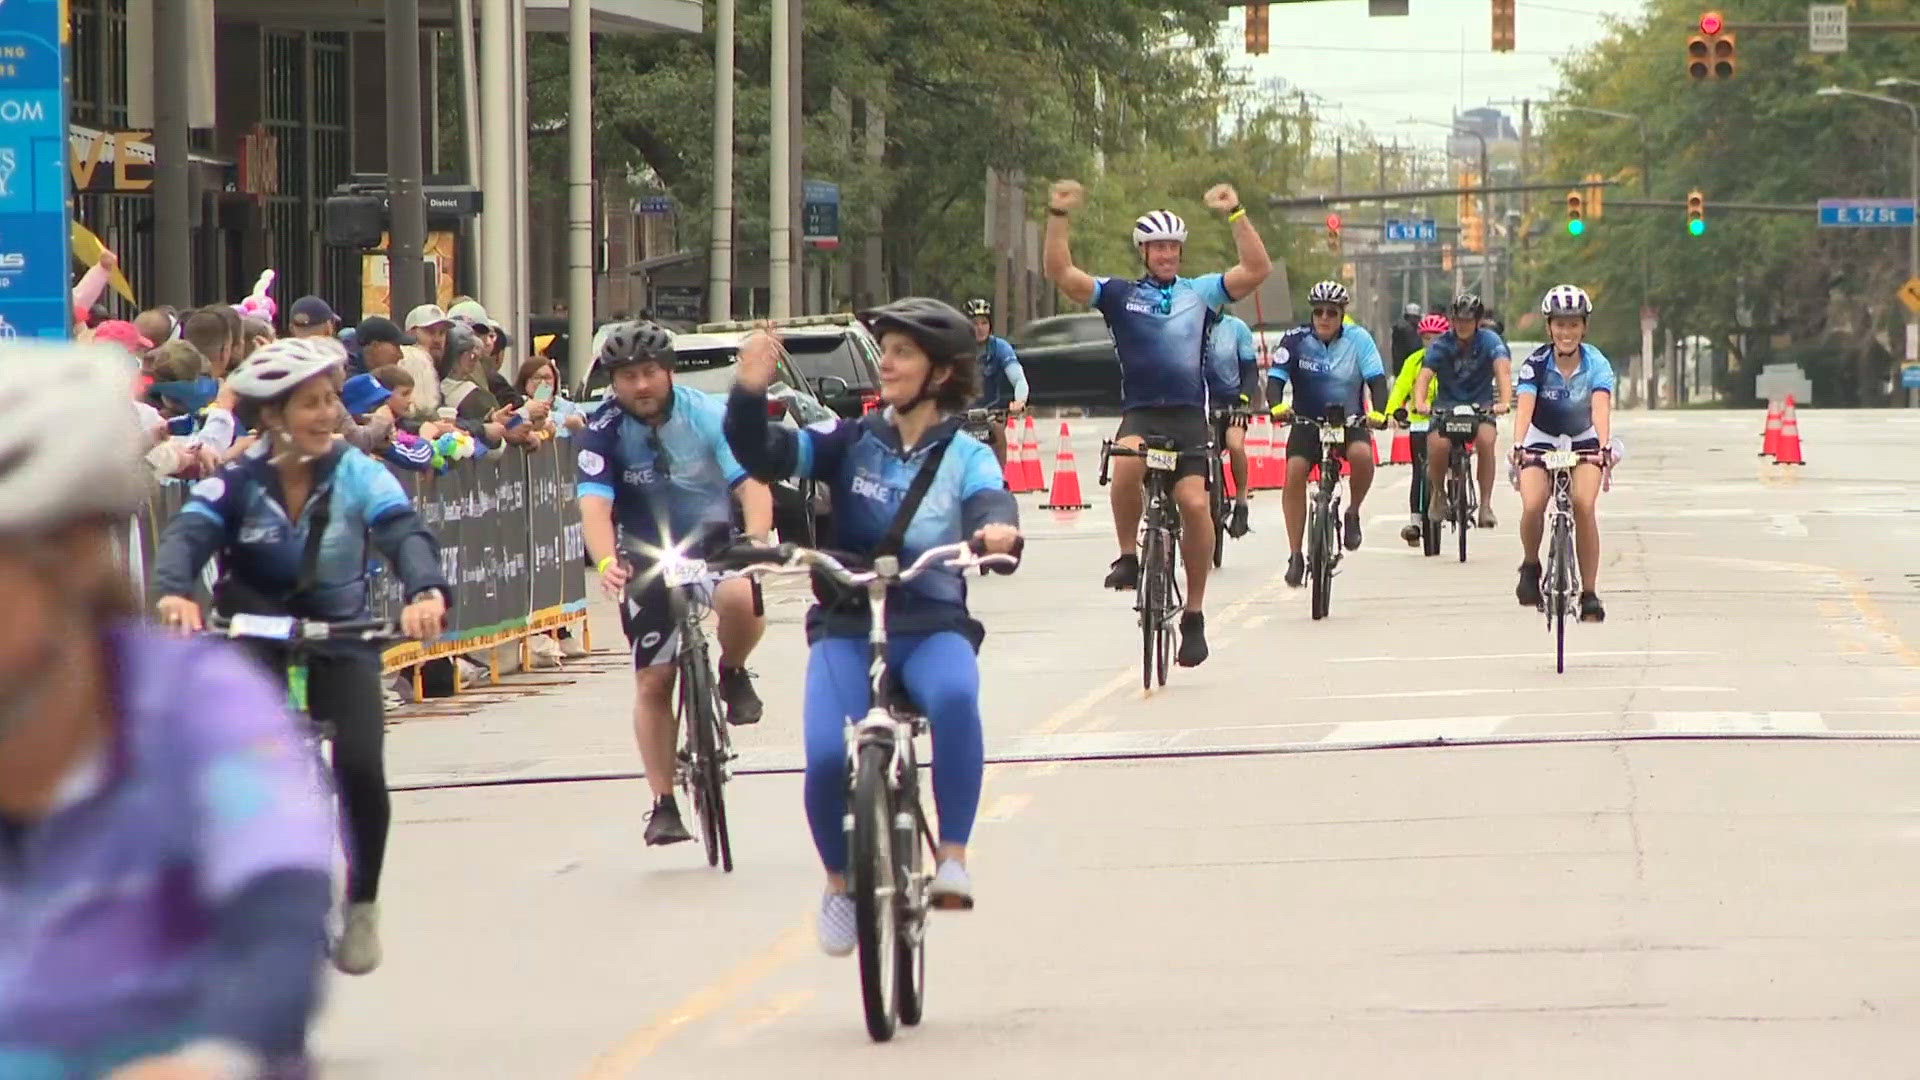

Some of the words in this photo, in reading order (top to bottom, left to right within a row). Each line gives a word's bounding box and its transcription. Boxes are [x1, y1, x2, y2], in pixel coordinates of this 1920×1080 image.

[430, 199, 458, 207] District
[1857, 208, 1875, 222] 12
[1879, 208, 1897, 222] St
[1403, 225, 1416, 239] 13
[1126, 302, 1150, 314] BIKE
[1298, 359, 1319, 371] BIKE
[623, 469, 654, 486] BIKE
[851, 476, 888, 504] BIKE
